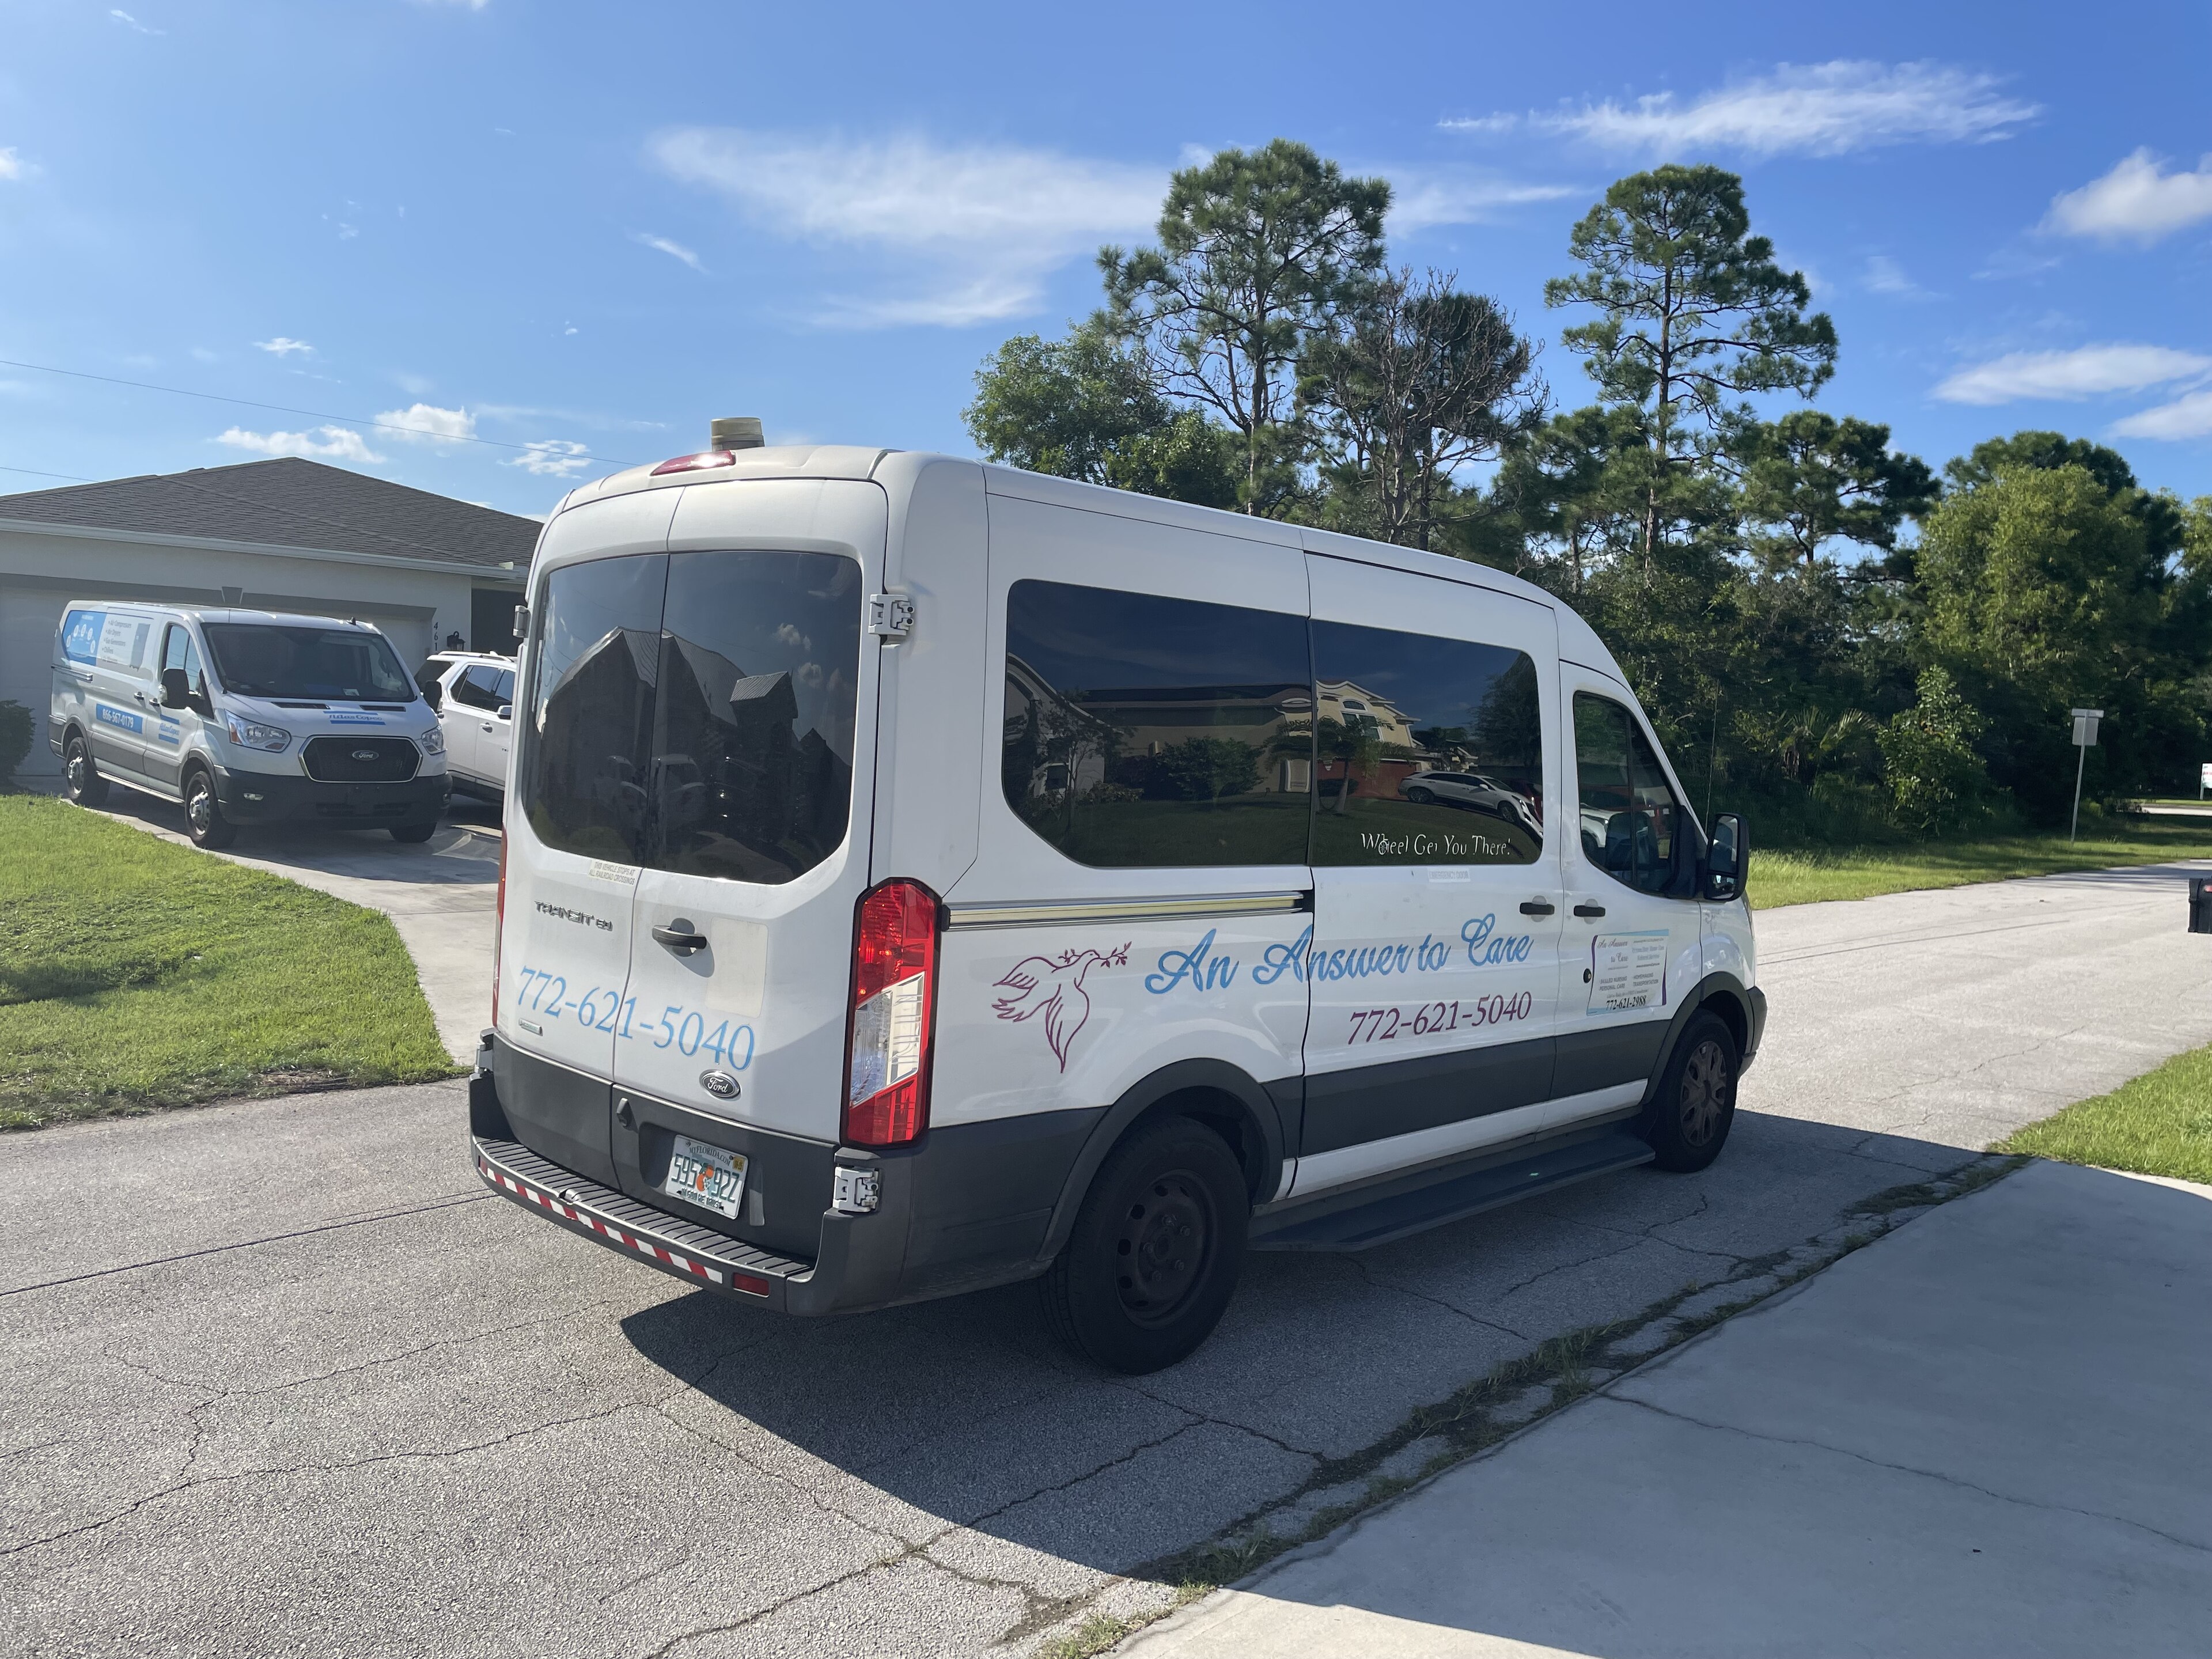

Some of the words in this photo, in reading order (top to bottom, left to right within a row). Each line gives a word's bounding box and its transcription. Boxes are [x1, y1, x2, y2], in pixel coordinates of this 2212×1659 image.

[102, 709, 134, 728] 866-567-0179
[169, 725, 180, 736] Copco
[1444, 835, 1467, 855] You
[595, 870, 614, 881] RAILROAD
[613, 874, 635, 885] CROSSINGS
[602, 863, 618, 873] VEHICLE
[616, 866, 630, 875] STOPS
[533, 900, 594, 926] TRANSIT
[1145, 928, 1239, 994] An
[1252, 923, 1414, 984] Answer
[1418, 933, 1452, 972] to
[1461, 913, 1535, 967] Care
[1606, 995, 1647, 1011] 772-621-2988
[517, 965, 756, 1071] 772-621-5040
[1348, 991, 1532, 1045] 772-621-5040
[707, 1077, 729, 1093] Ford
[689, 1146, 731, 1166] MYFLORIDA.COM
